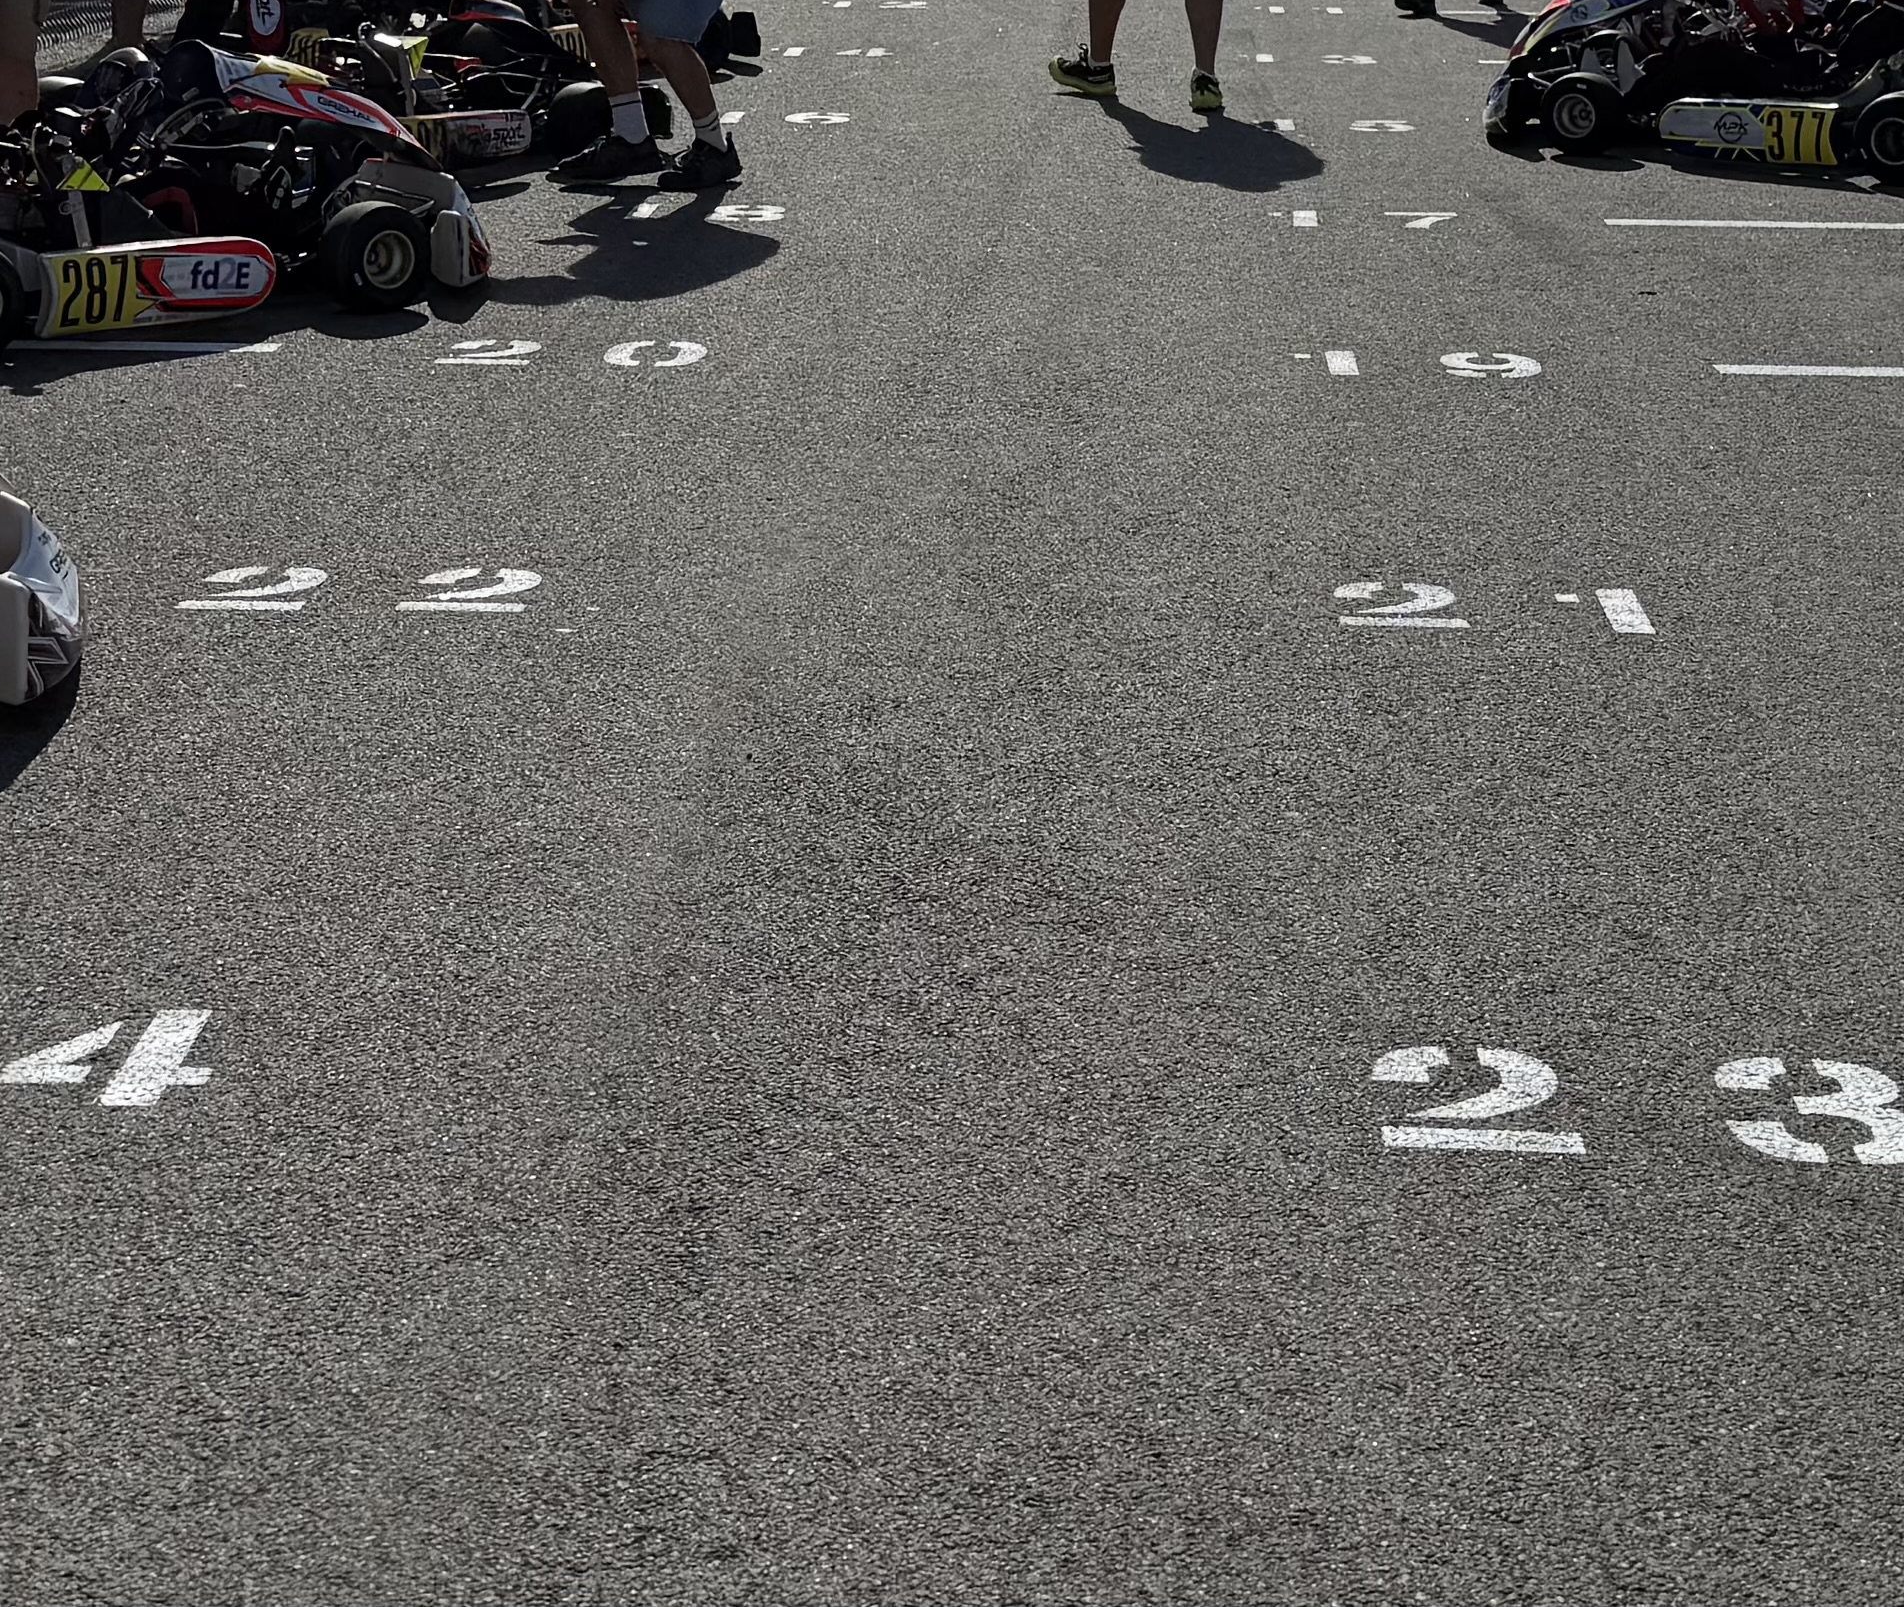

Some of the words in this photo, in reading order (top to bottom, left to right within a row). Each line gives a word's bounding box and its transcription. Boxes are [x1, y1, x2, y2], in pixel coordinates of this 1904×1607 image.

[317, 94, 378, 123] GREHAL
[1766, 110, 1826, 162] 377
[59, 254, 129, 328] 287
[191, 257, 250, 290] fd2E
[434, 339, 708, 367] 20
[1295, 350, 1543, 379] 19
[174, 565, 543, 613] 22
[1333, 581, 1657, 635] 21
